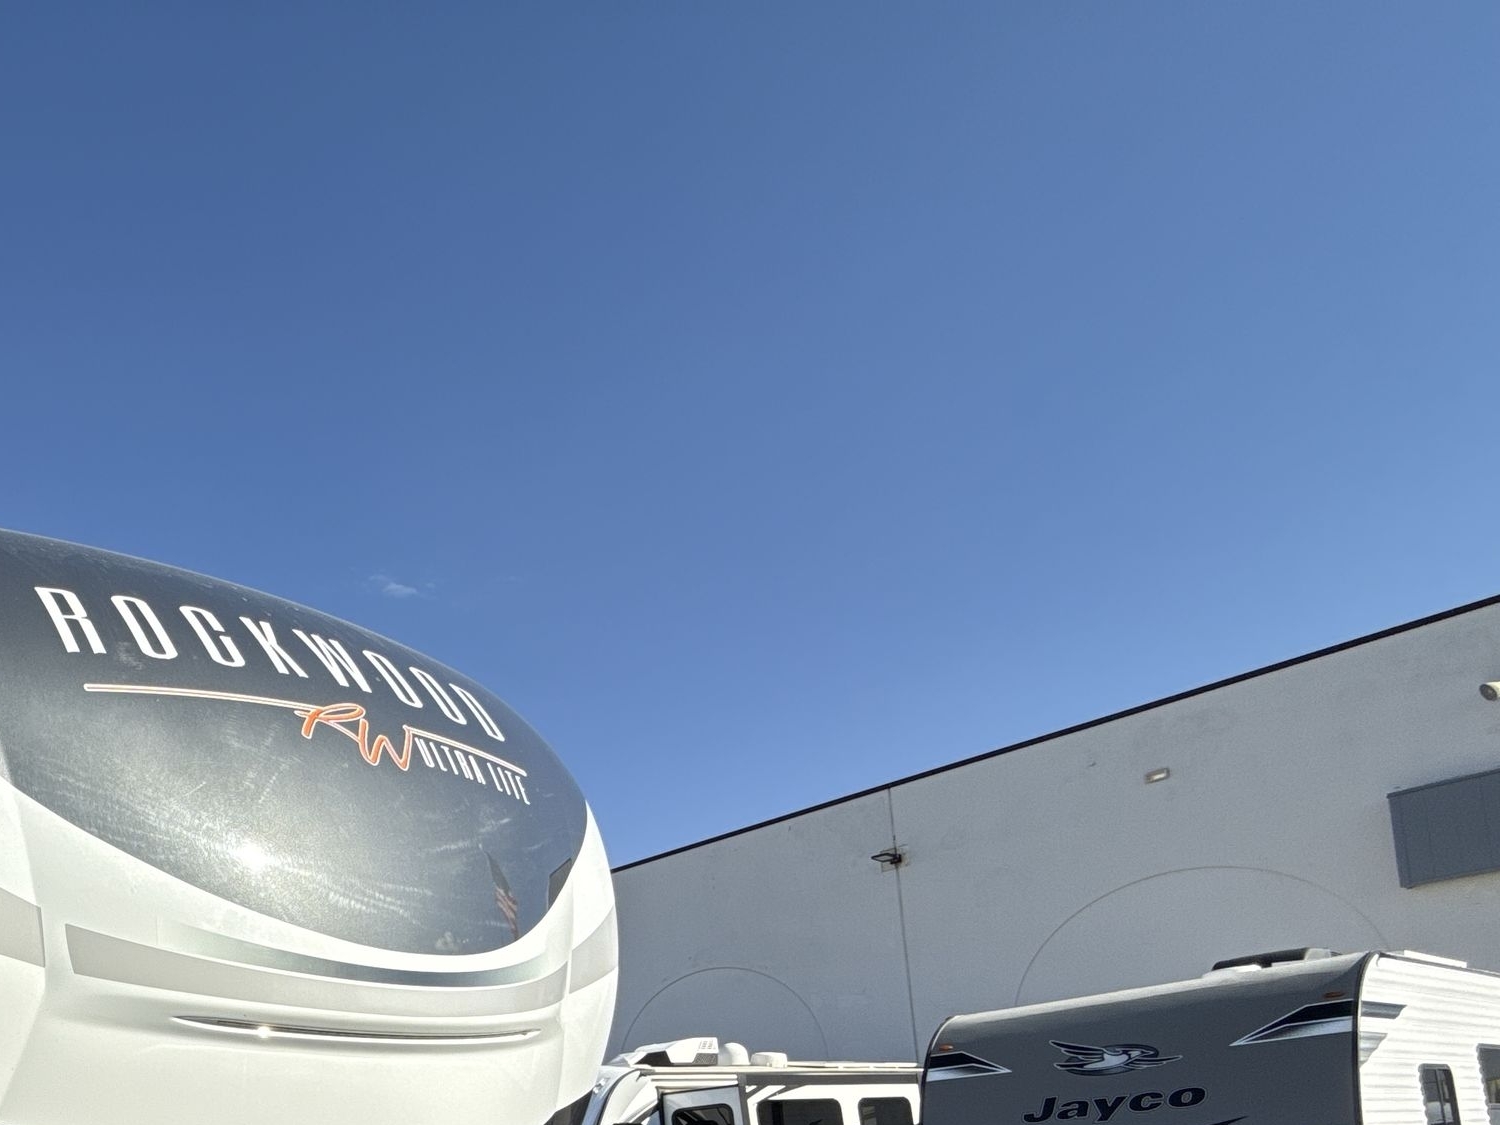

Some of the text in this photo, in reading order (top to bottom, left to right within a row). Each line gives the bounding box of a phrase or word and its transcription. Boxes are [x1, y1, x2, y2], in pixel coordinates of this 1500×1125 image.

[35, 586, 505, 742] ROCKWOOD
[414, 737, 531, 805] ULTRA LITE
[1022, 1086, 1207, 1124] Jayco
